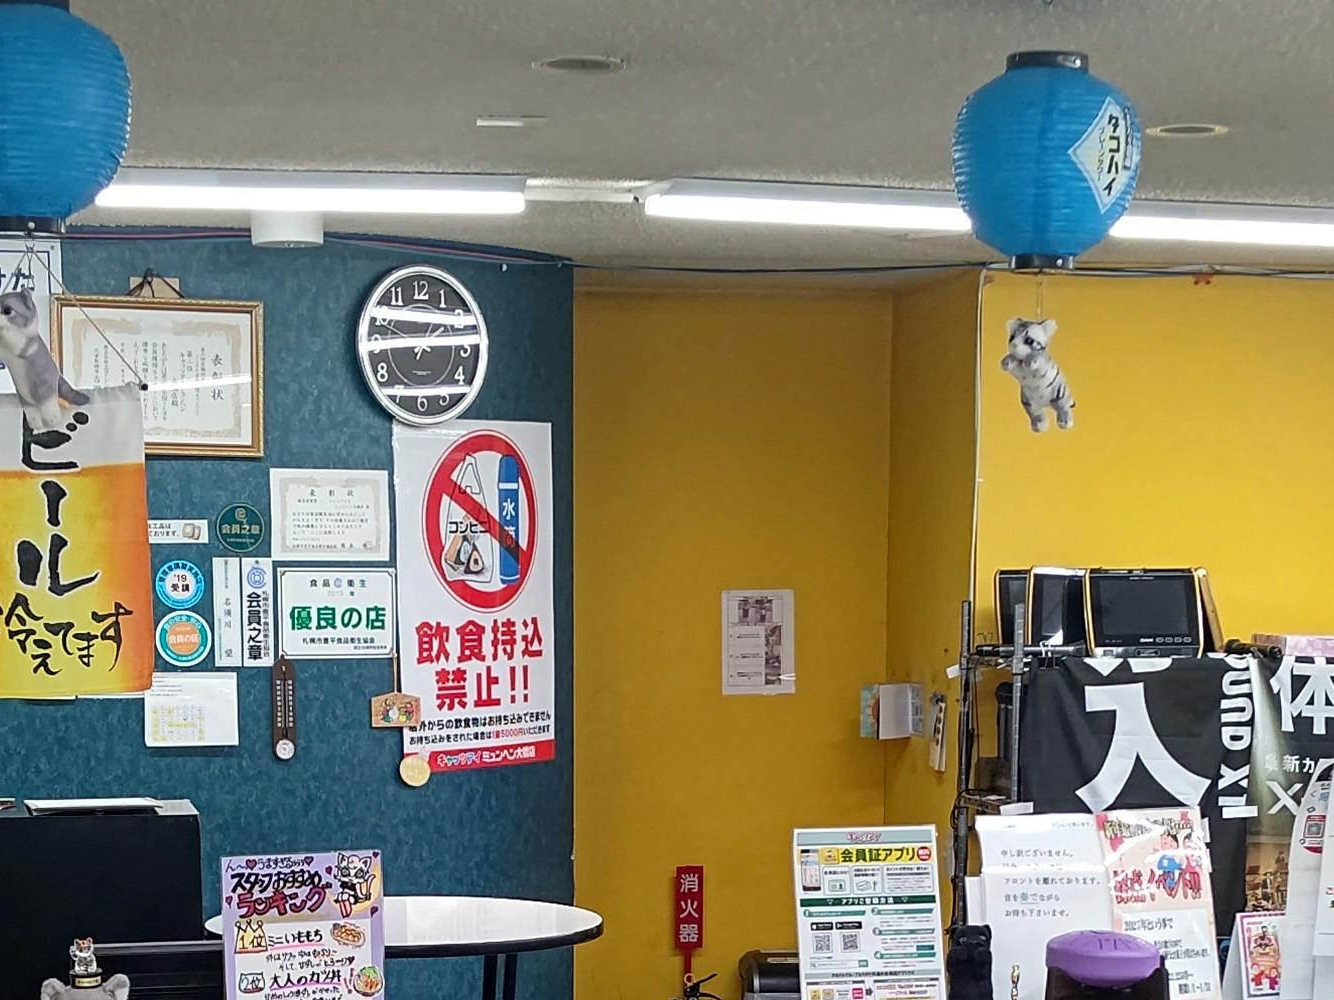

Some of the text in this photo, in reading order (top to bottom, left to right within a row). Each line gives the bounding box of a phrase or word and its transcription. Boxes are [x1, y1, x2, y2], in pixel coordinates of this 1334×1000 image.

[1102, 114, 1121, 196] タコハイ
[390, 288, 403, 307] 11
[413, 280, 429, 299] 12
[377, 363, 388, 382] 8
[454, 366, 465, 385] 4
[417, 394, 428, 411] 6
[18, 410, 102, 596] ビール
[449, 521, 490, 534] コンビニ
[310, 579, 367, 588] 食品 衛生
[247, 592, 263, 660] 会員之章
[290, 606, 386, 630] 優良の店
[415, 618, 544, 665] 飲食持込
[434, 666, 529, 712] 禁止!!
[1074, 682, 1212, 813] 入
[841, 847, 916, 862] 会員証アプリ
[1000, 849, 1074, 858] 申し訳ございません。
[231, 868, 323, 894] スタッフおすすめ
[237, 882, 332, 918] ランキング
[677, 873, 700, 944] 消火器
[1005, 909, 1071, 918] お待ち下さいませ。
[240, 935, 263, 949] 1位
[270, 969, 341, 988] 大人のカツ丼
